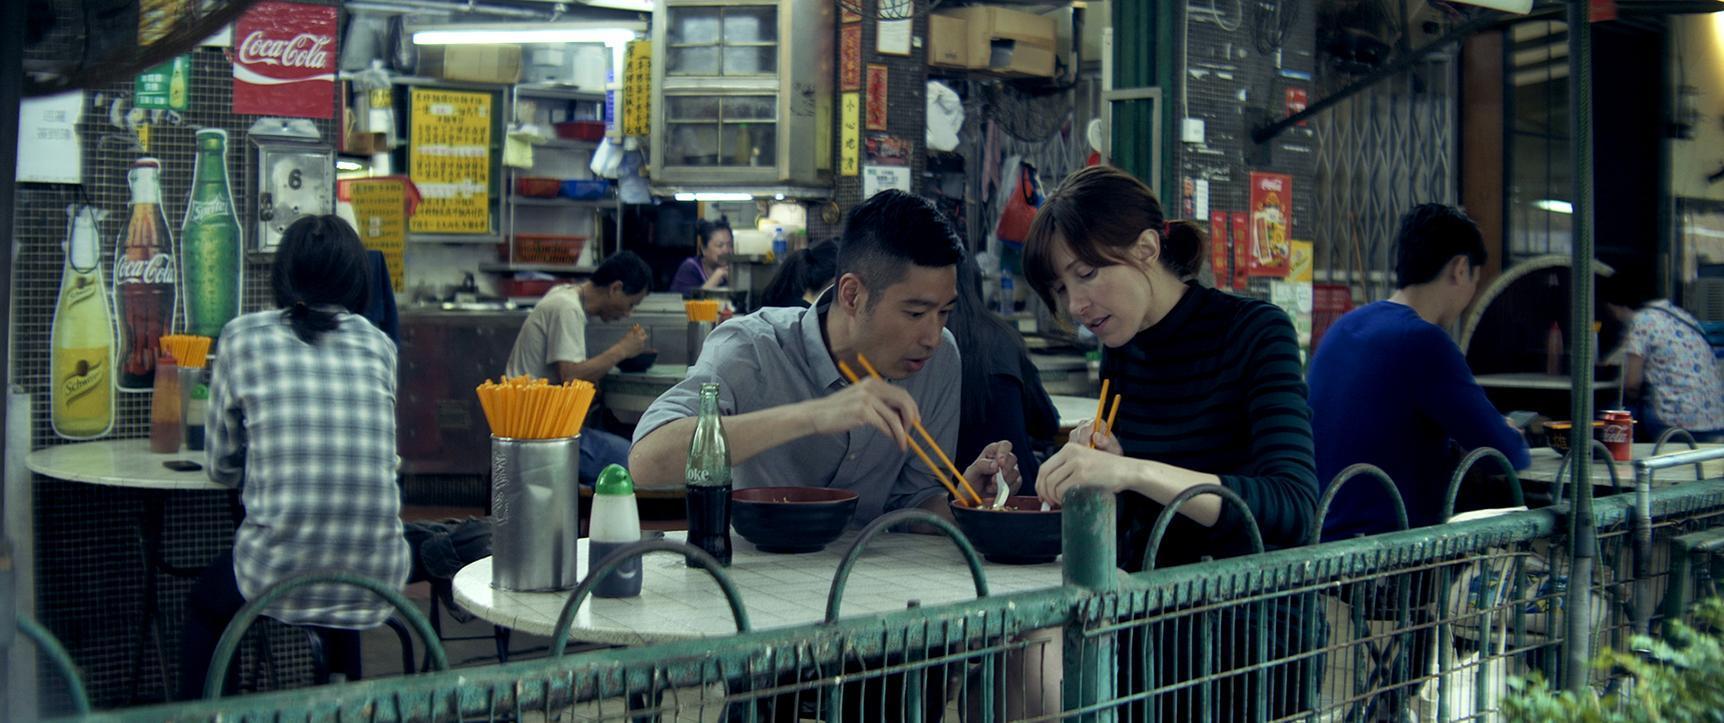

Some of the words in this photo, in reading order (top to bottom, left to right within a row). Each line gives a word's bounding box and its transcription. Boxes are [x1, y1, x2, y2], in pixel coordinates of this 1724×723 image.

[239, 31, 333, 69] Coca-Cola
[287, 168, 302, 190] 6
[116, 254, 175, 285] Coca-Cola
[687, 468, 710, 481] oke
